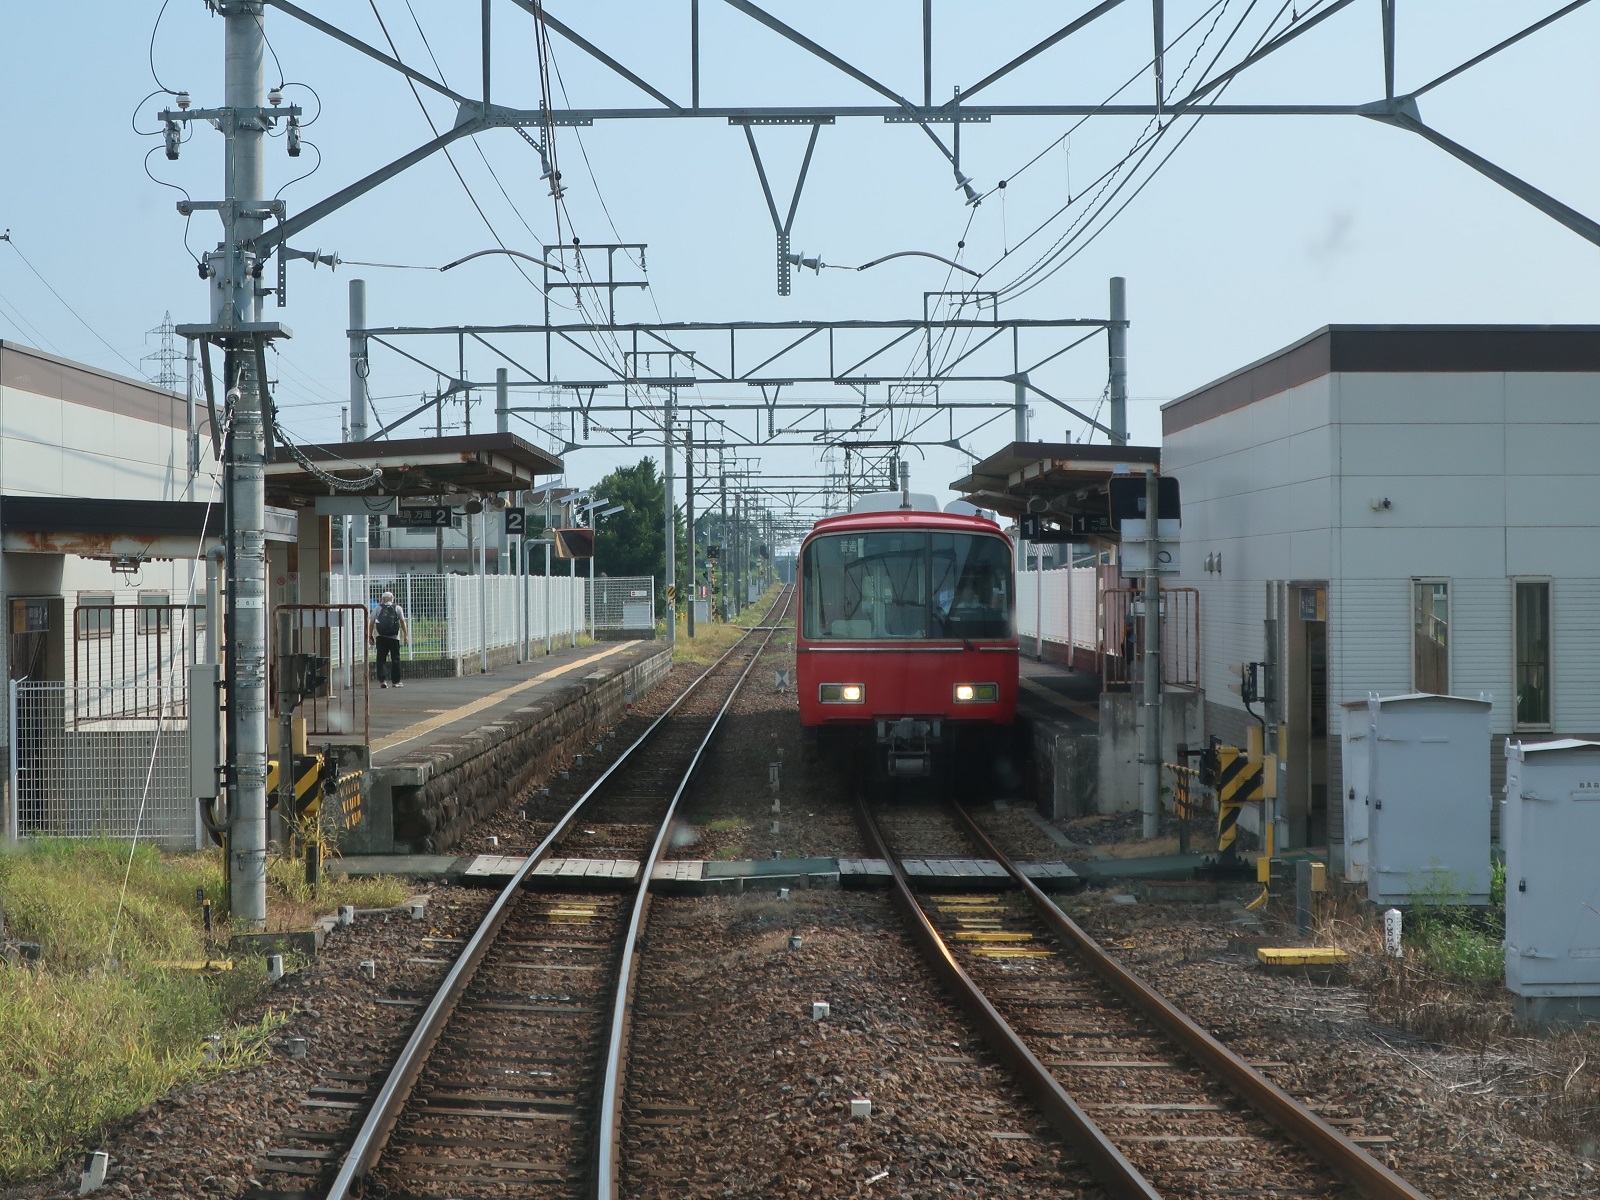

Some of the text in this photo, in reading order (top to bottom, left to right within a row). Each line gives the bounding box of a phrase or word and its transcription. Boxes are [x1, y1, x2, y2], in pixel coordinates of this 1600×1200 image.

[436, 509, 446, 524] 2
[508, 513, 522, 529] 2
[1079, 517, 1085, 531] 1
[1024, 519, 1034, 535] 1
[840, 540, 857, 553] 普通
